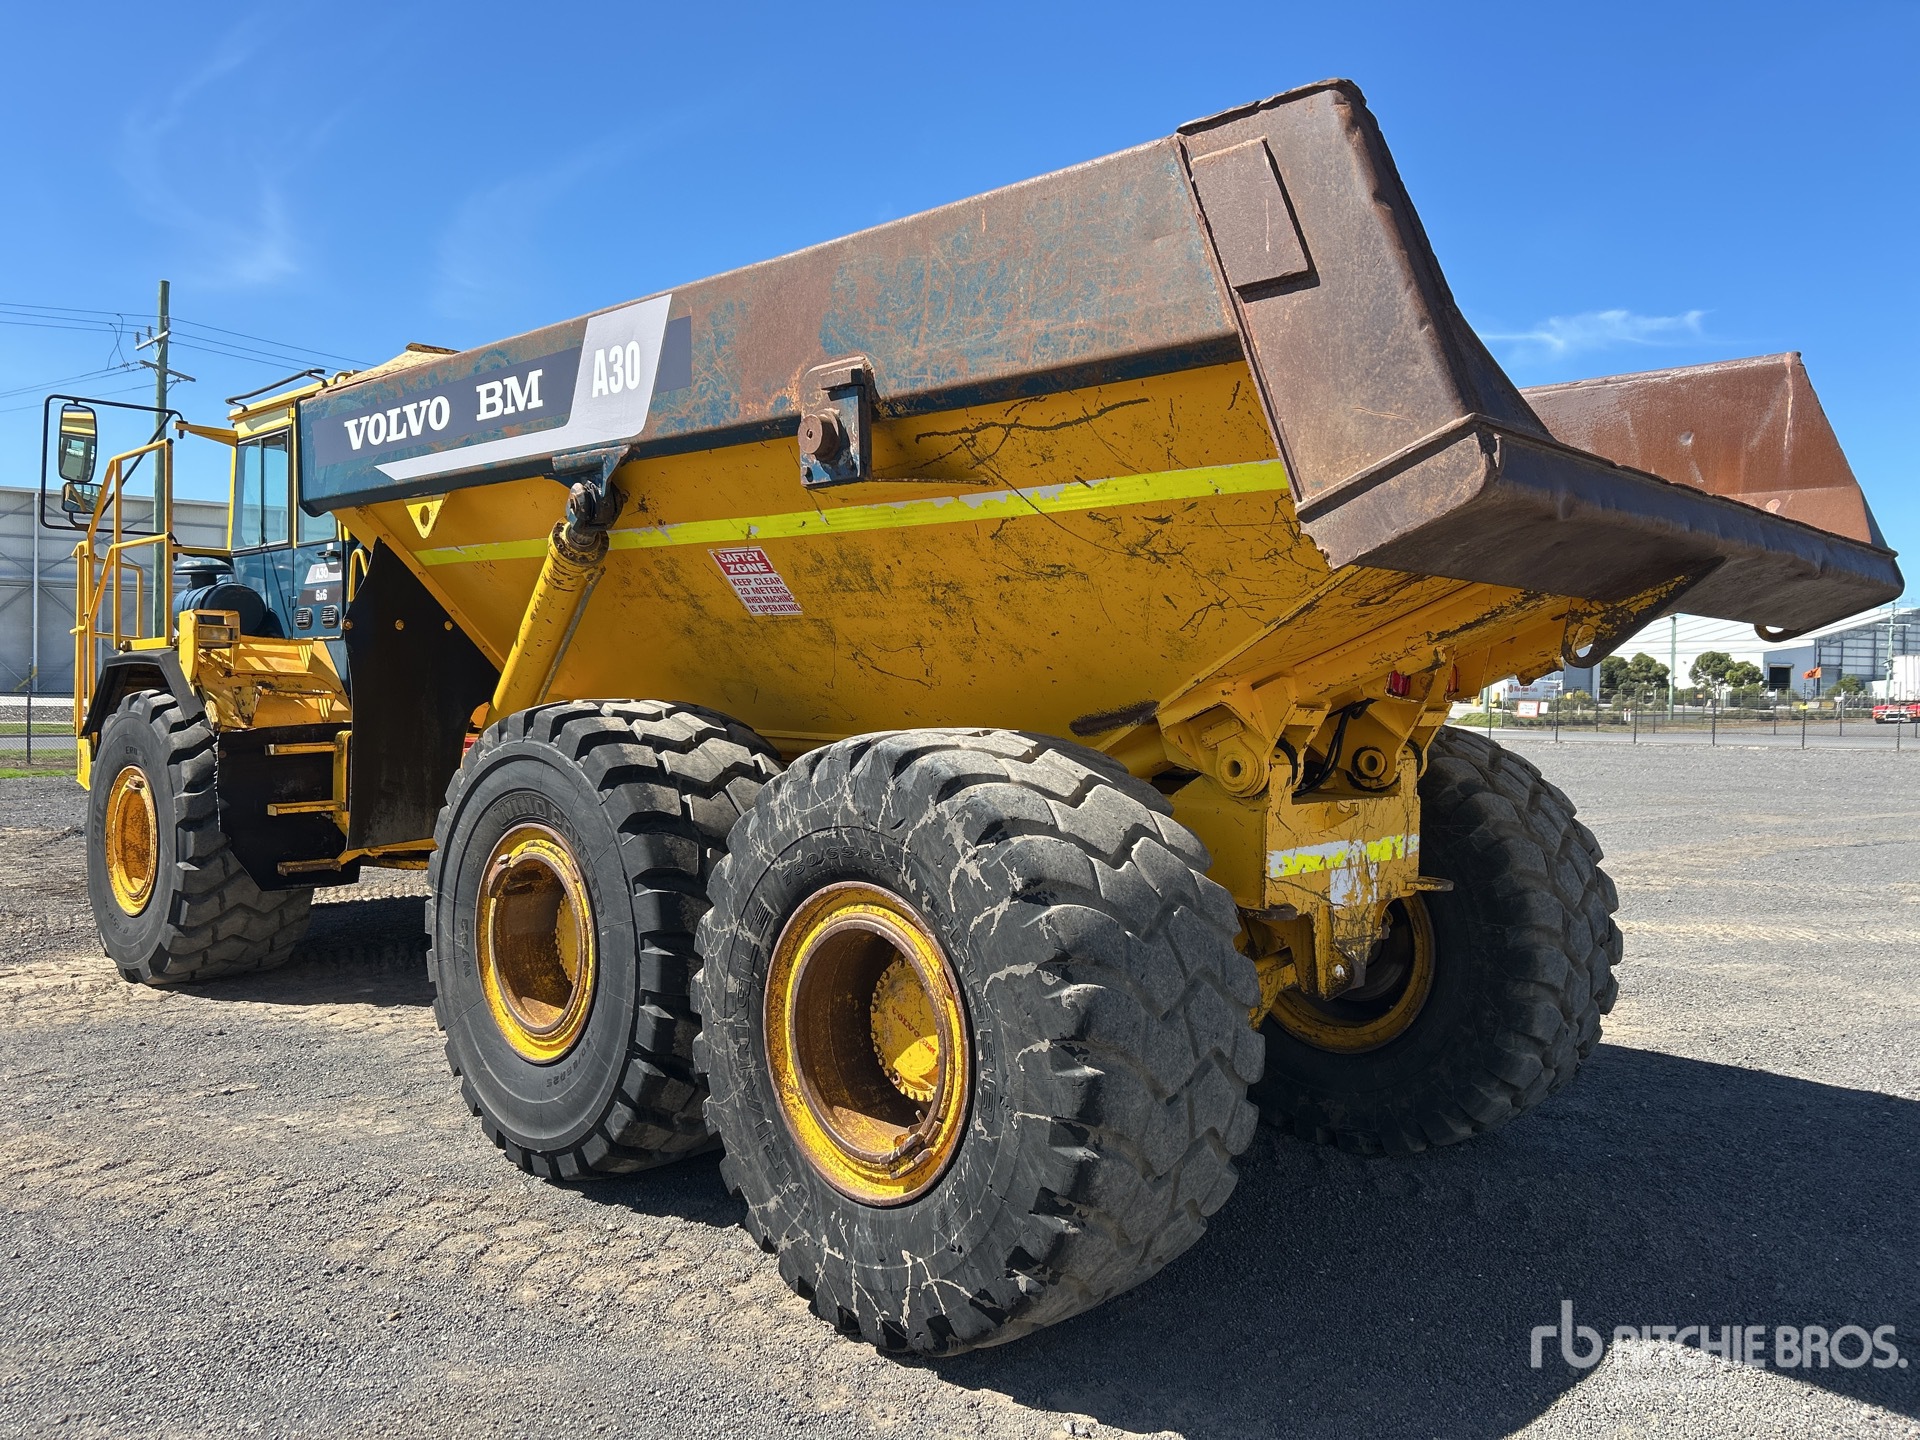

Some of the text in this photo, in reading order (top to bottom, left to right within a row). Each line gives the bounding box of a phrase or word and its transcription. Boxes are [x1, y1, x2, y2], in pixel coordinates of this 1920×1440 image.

[591, 340, 641, 399] A30
[344, 368, 544, 451] VOLVO BM
[315, 566, 329, 580] A30
[726, 562, 770, 574] ZONE
[730, 576, 783, 587] KEEP CLEAR
[315, 588, 328, 602] 6x6
[738, 586, 788, 595] 20 METERS
[743, 596, 764, 604] WHEN
[749, 605, 758, 613] IS
